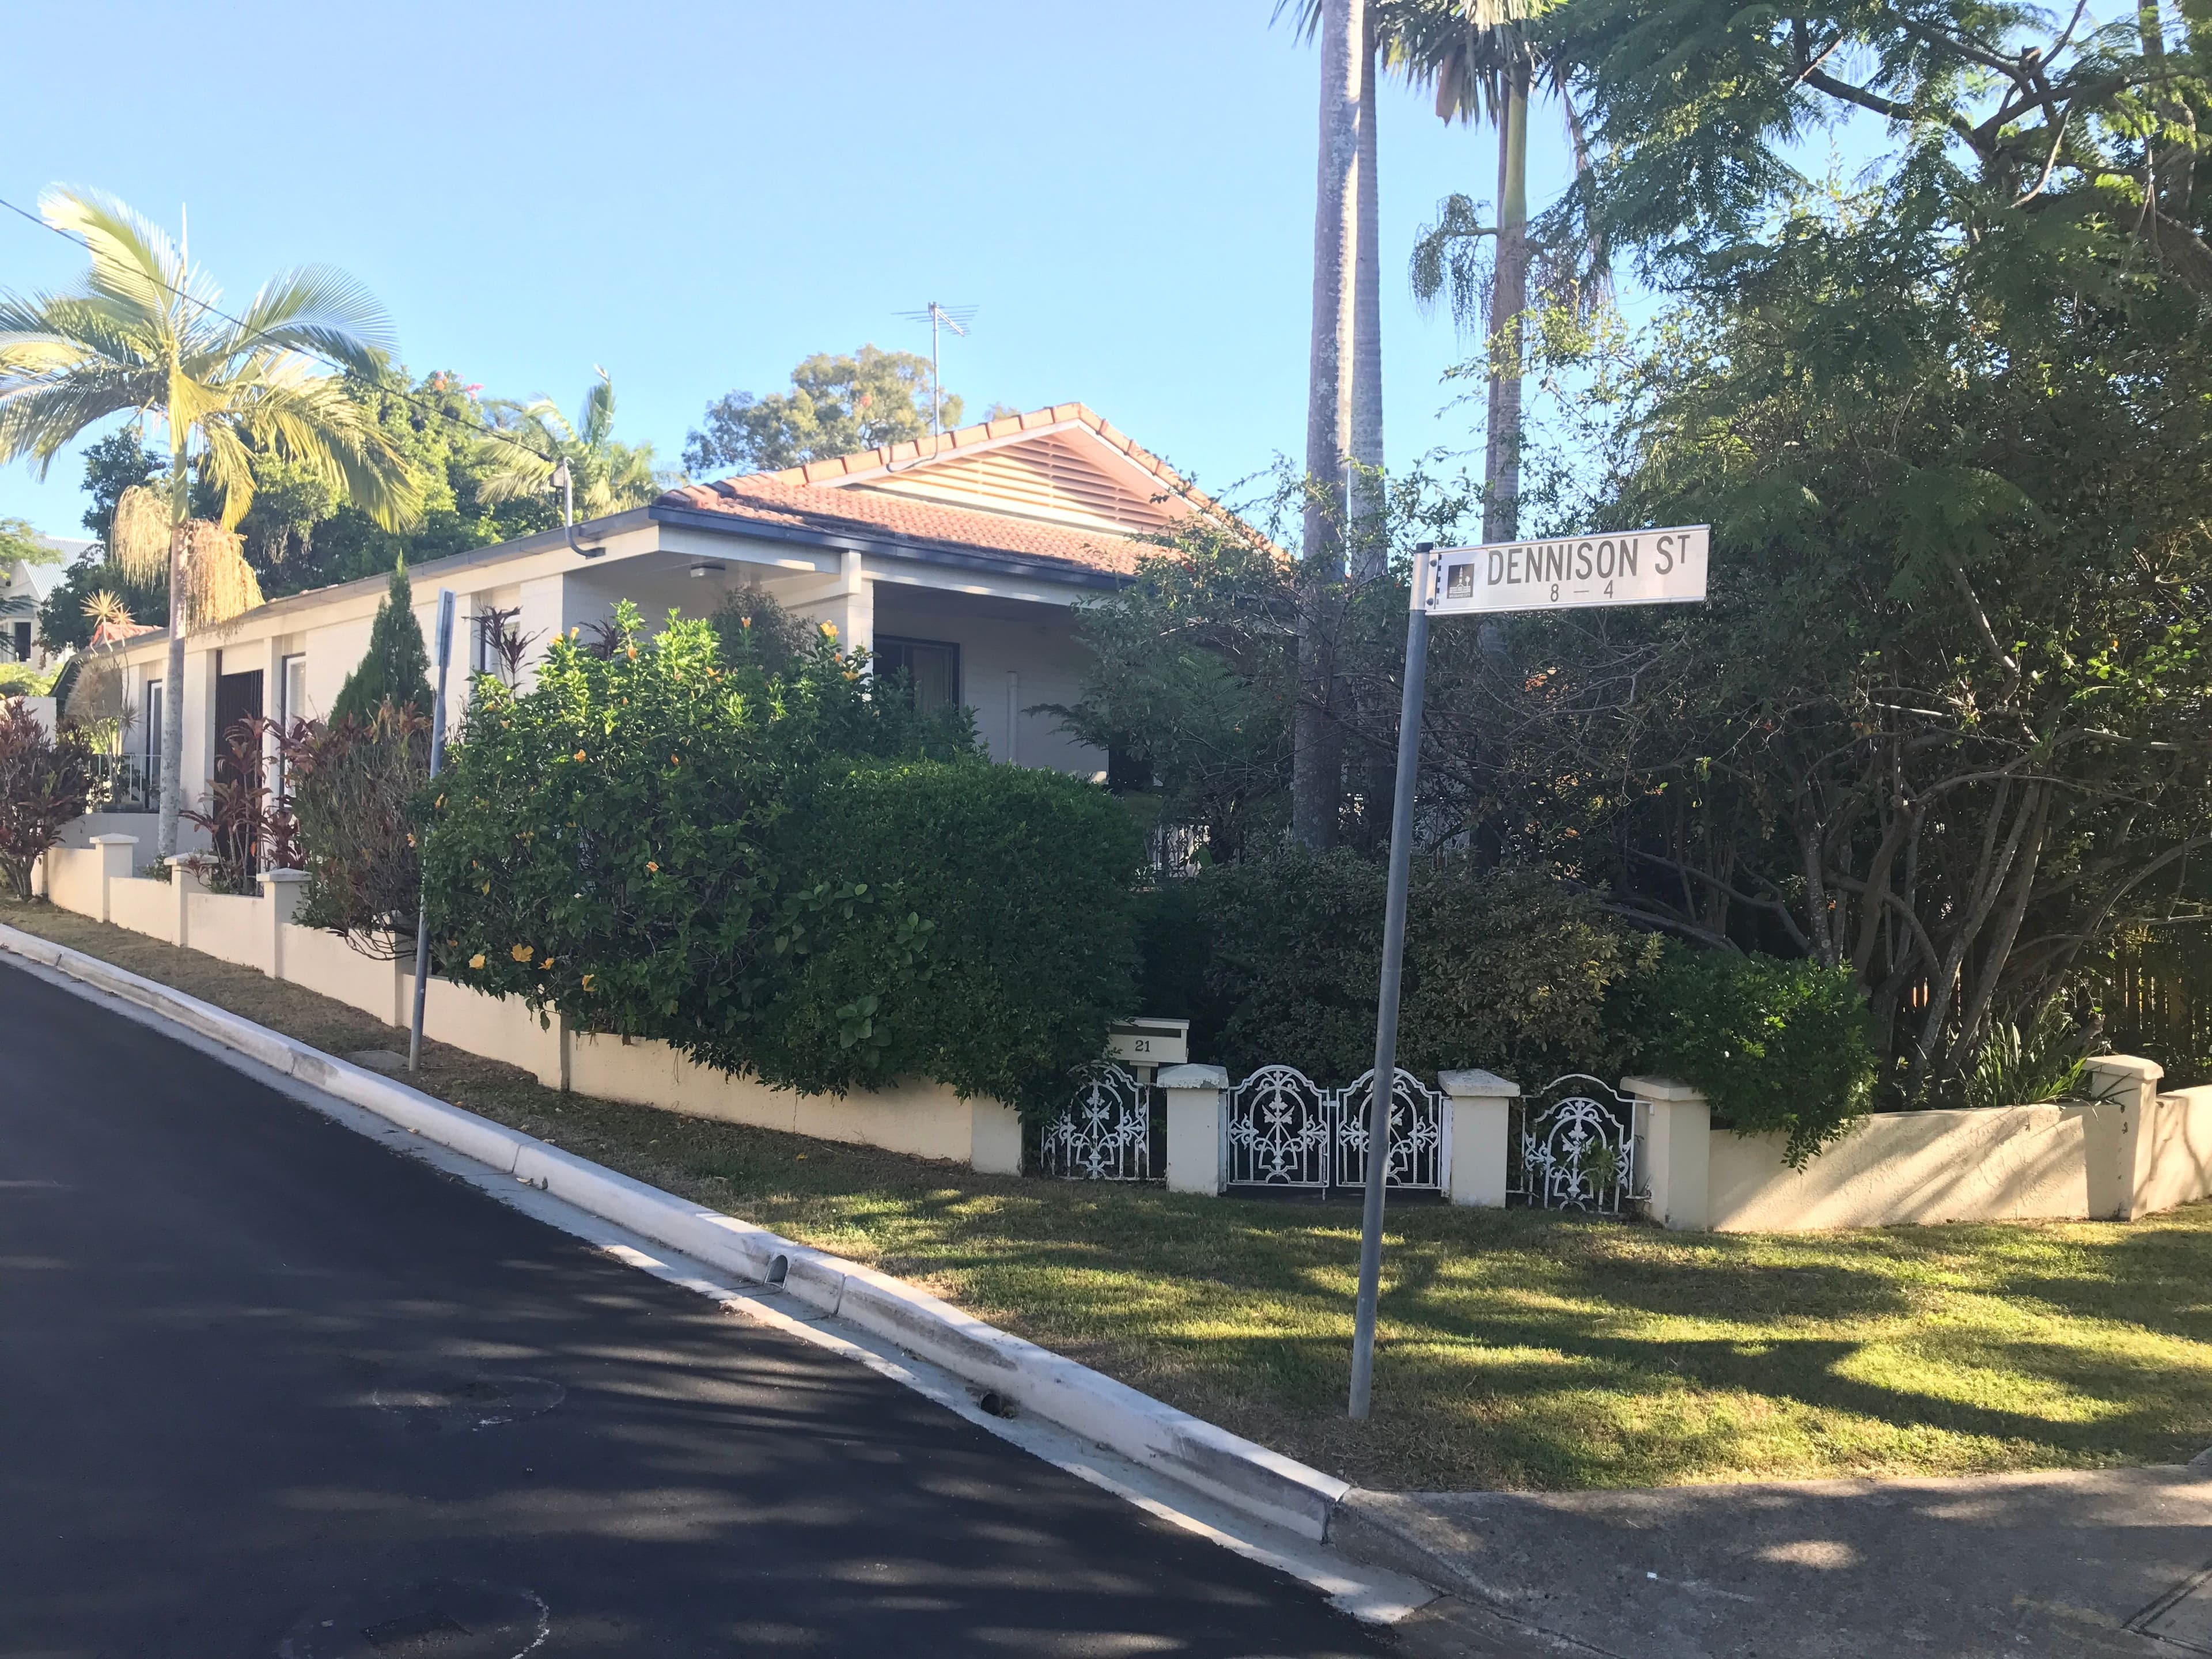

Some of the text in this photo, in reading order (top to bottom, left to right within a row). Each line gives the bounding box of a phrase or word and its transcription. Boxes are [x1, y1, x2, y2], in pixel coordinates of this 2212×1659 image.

[1488, 535, 1690, 585] DENNISON ST
[1550, 583, 1559, 602] 8
[1603, 579, 1613, 599] 4
[1135, 1040, 1150, 1052] 21
